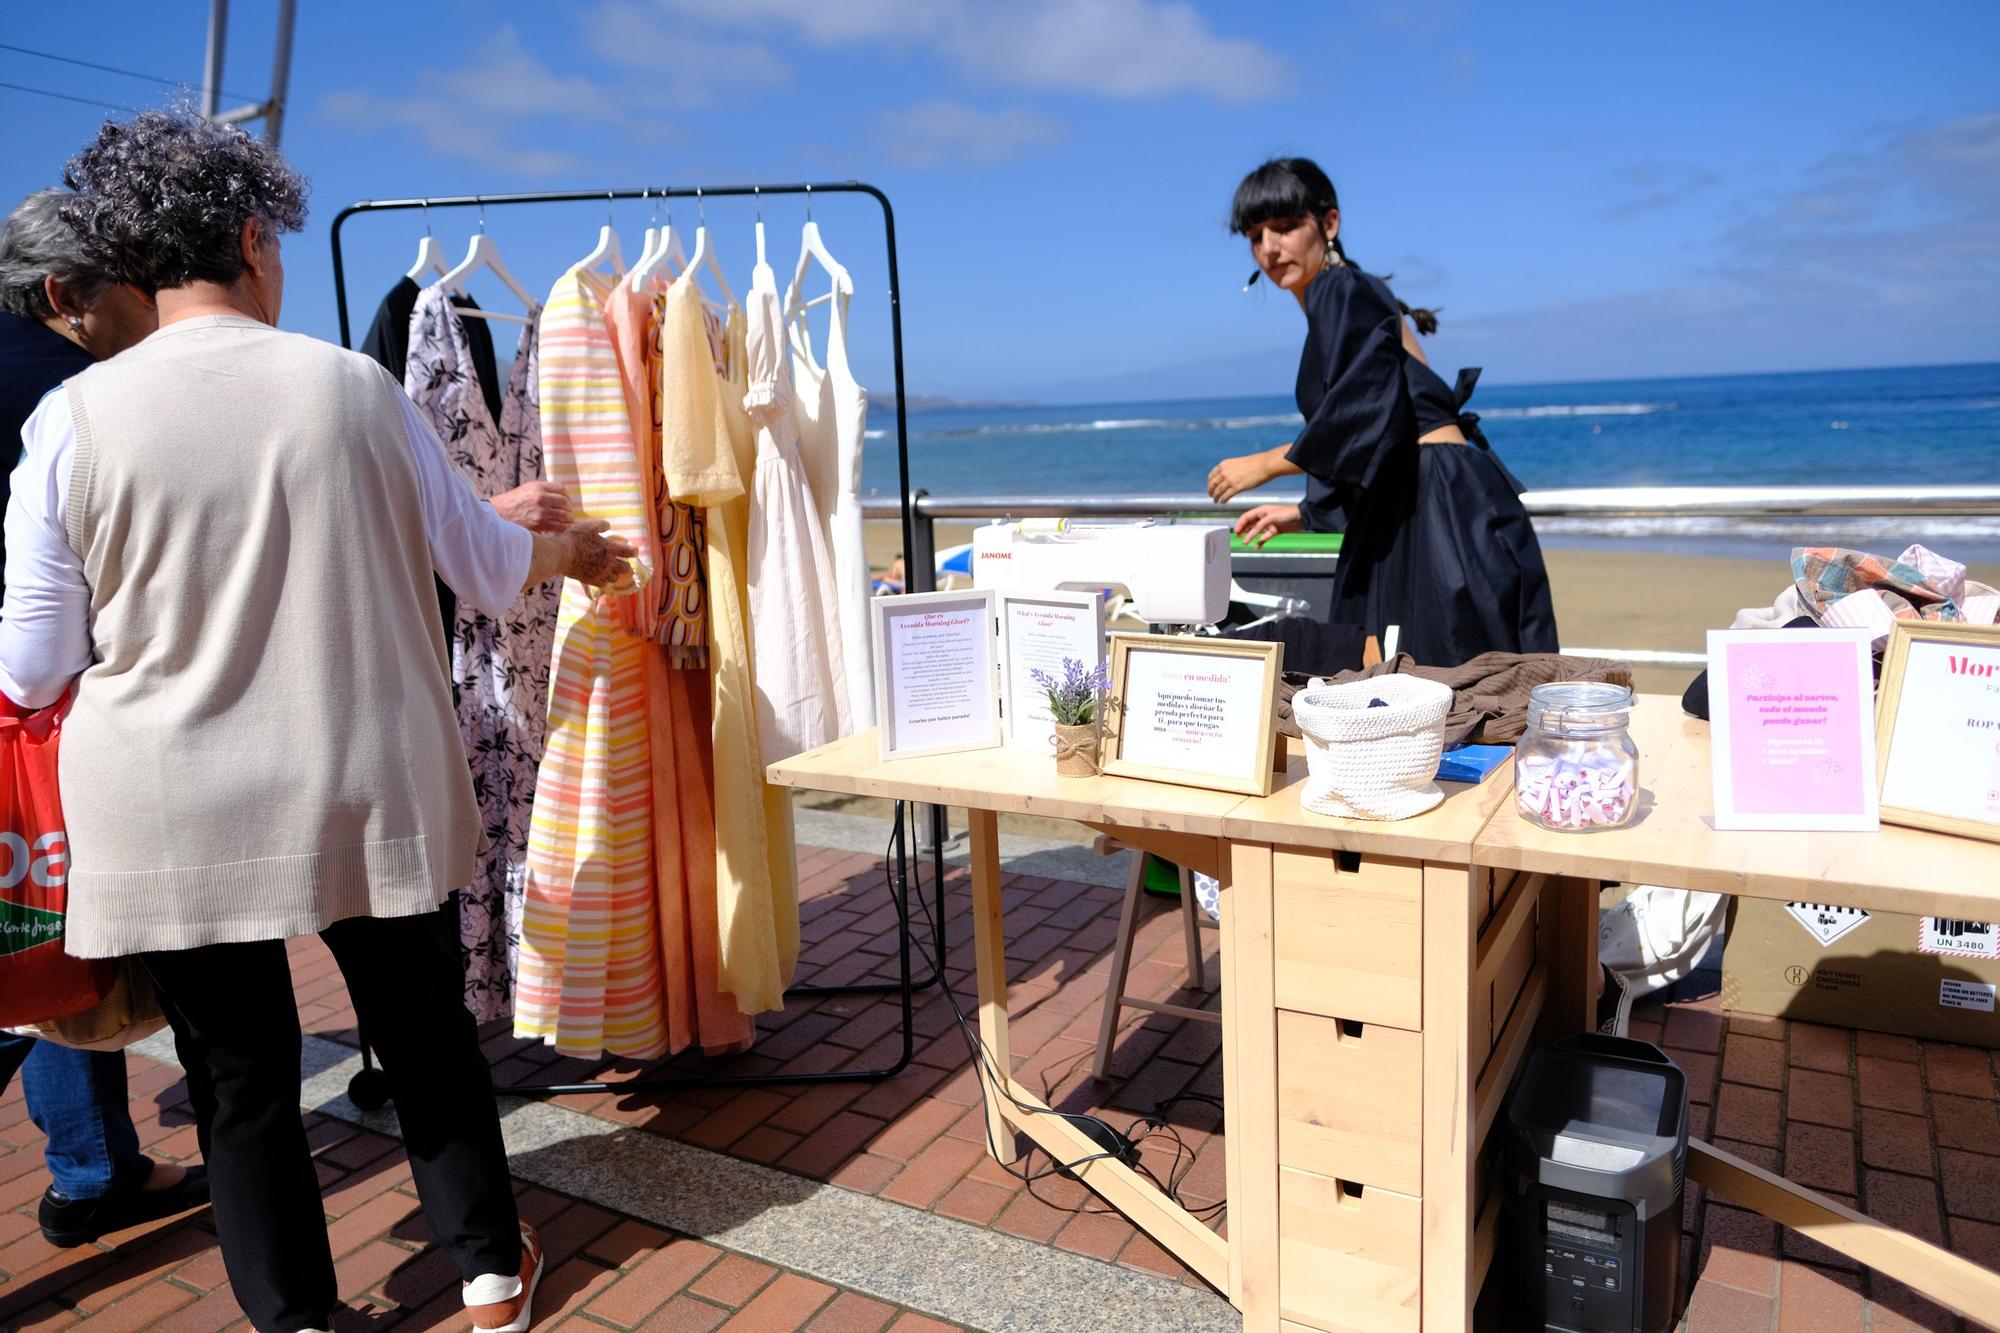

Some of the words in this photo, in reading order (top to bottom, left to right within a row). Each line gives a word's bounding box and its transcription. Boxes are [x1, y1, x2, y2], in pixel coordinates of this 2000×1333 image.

[981, 552, 1012, 560] JANOME
[925, 620, 950, 628] Morning
[1196, 674, 1231, 684] medida!
[1172, 693, 1193, 702] puedo
[1193, 695, 1214, 703] tomar
[1747, 694, 1792, 702] Participa
[1157, 700, 1184, 708] medidas
[1216, 705, 1223, 713] la
[1792, 705, 1828, 713] mundo
[1154, 709, 1178, 717] prenda
[1179, 711, 1207, 719] perfecta
[1184, 720, 1196, 728] que
[1197, 721, 1220, 730] tengas
[1762, 717, 1792, 727] puede
[1793, 717, 1827, 726] ganar!
[1937, 938, 1953, 947] UN
[1956, 940, 1985, 950] 3480
[1970, 990, 1993, 998] BATTERIES
